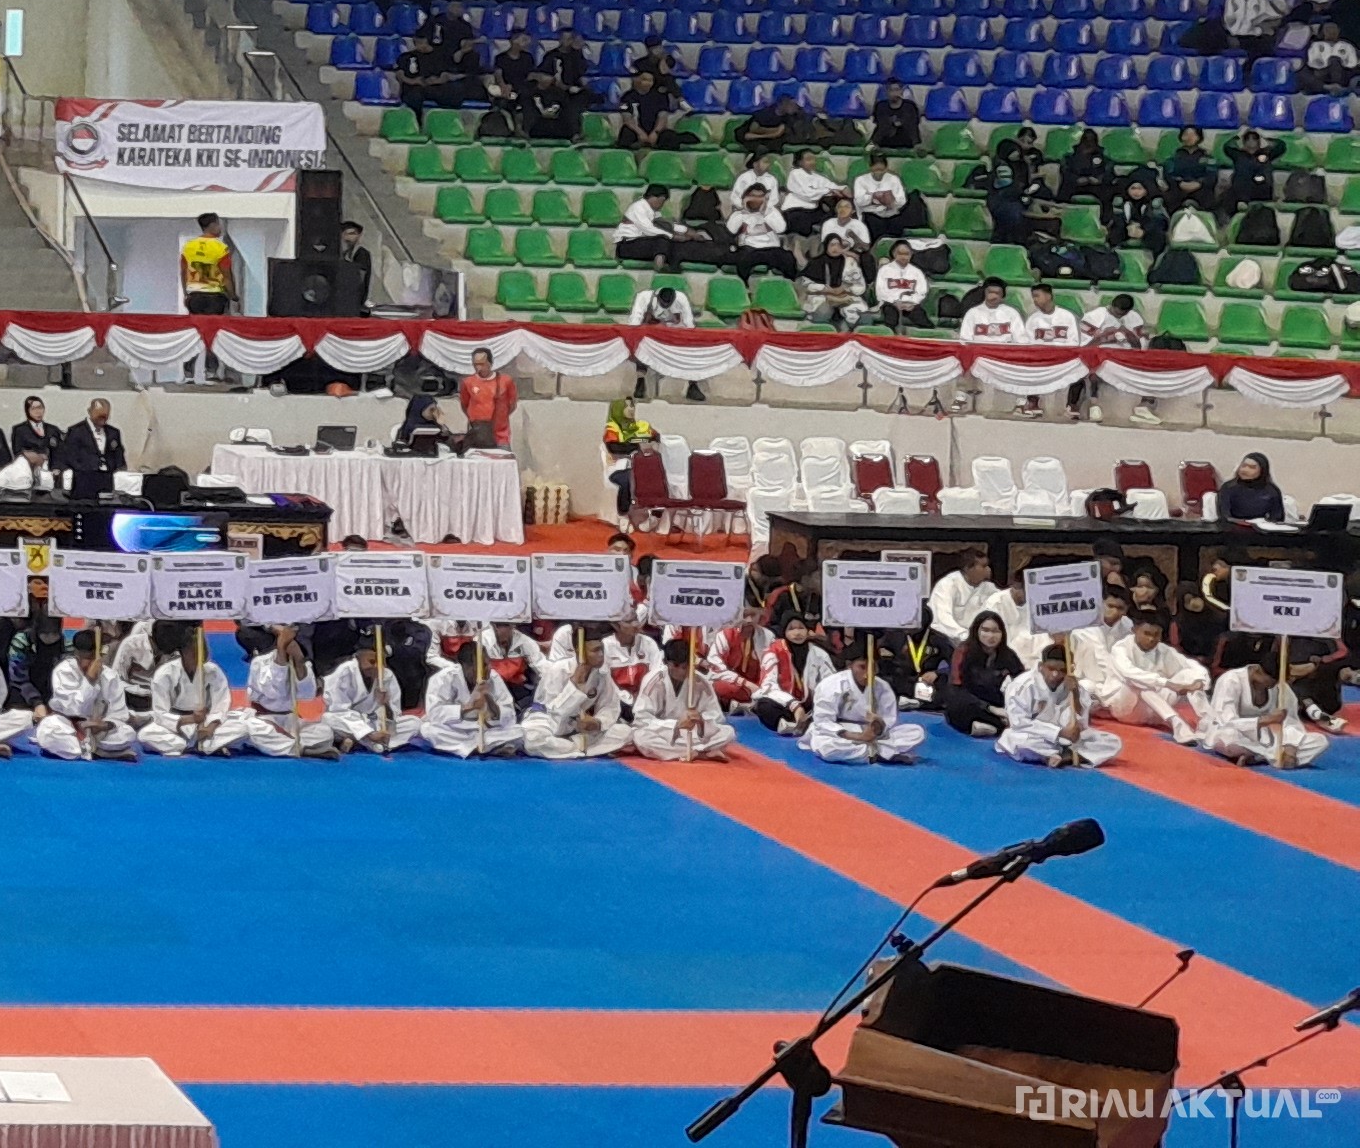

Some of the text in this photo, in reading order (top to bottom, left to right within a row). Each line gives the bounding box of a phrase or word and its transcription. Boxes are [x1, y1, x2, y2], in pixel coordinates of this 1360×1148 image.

[116, 123, 283, 145] SELAMAT BERTANDING
[116, 147, 193, 168] KARATEKA
[195, 148, 220, 168] KKI
[177, 588, 223, 600] BLACK
[275, 591, 319, 604] FORKI
[443, 588, 514, 602] GOJUKAI
[553, 588, 608, 601] GOKASI
[168, 600, 233, 611] PANTHER
[669, 594, 726, 608] INKADO
[851, 596, 894, 609] INKAI
[1036, 598, 1096, 617] INKANAS
